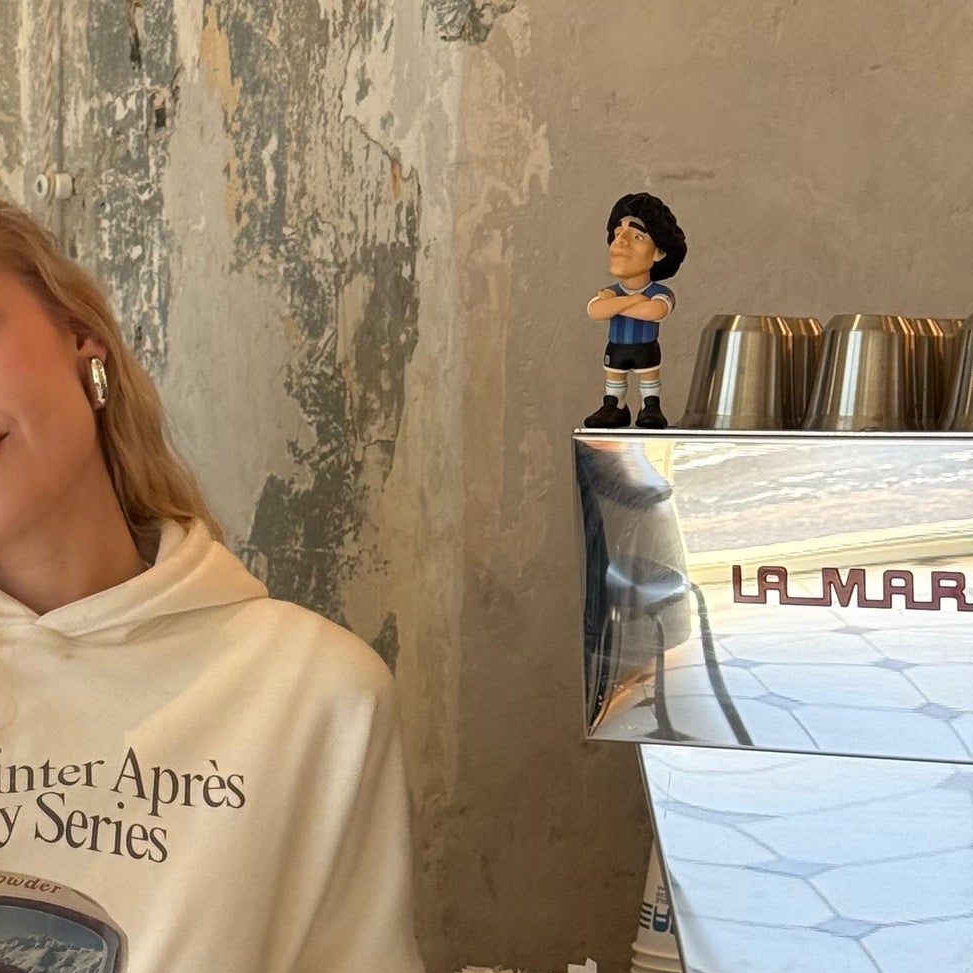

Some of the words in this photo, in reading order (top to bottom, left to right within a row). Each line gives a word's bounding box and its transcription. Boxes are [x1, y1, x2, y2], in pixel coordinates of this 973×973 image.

[732, 564, 789, 604] LA
[110, 746, 246, 818] Après
[34, 791, 168, 863] Series
